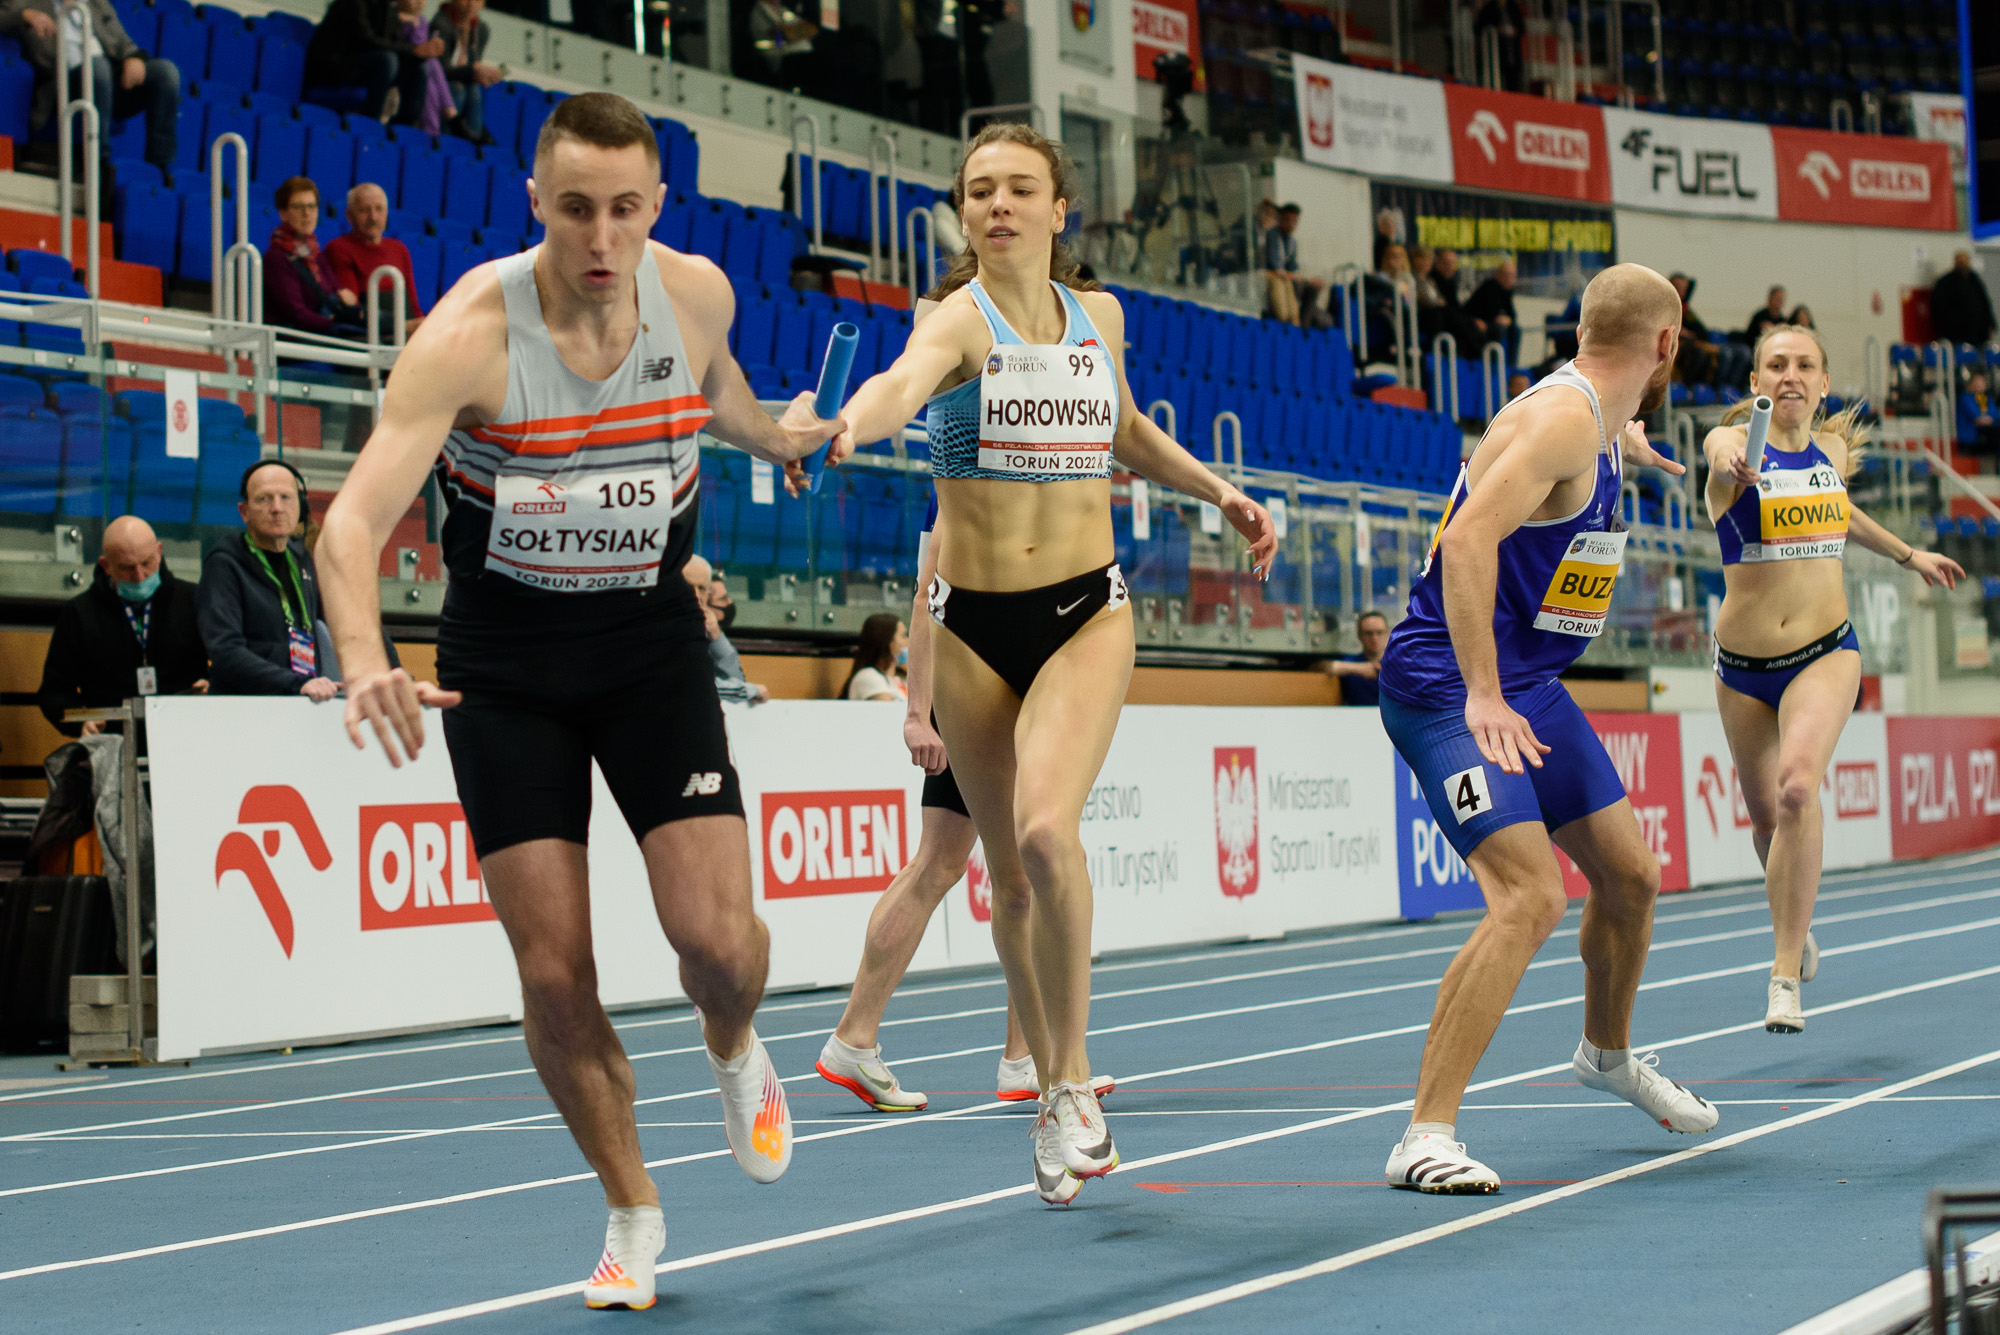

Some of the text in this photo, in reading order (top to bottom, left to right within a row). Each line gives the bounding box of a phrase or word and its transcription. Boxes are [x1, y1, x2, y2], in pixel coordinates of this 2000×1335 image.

[1522, 130, 1586, 161] ORLEN
[1622, 129, 1651, 158] 4F
[1652, 146, 1757, 199] FUEL
[1857, 166, 1925, 193] ORLEN
[1006, 360, 1049, 373] TORUŃ
[1068, 354, 1095, 377] 99
[987, 398, 1112, 427] HOROWSKA
[1004, 452, 1097, 470] TORUŃ 2022
[598, 480, 656, 509] 105
[514, 502, 564, 514] ORLEN
[1773, 502, 1845, 528] KOWAL
[498, 528, 660, 553] SOŁTYSIAK
[1587, 545, 1618, 556] TORUŃ
[1779, 542, 1819, 558] TORUŃ
[514, 570, 631, 589] TORUŃ 2022
[1557, 619, 1601, 634] TORUŃ
[1766, 644, 1823, 669] AdRunaLine
[1456, 772, 1481, 812] 4
[1901, 752, 1960, 825] PZLA
[1081, 785, 1142, 822] erstwo
[769, 804, 901, 886] ORLEN
[368, 820, 492, 914] ORL
